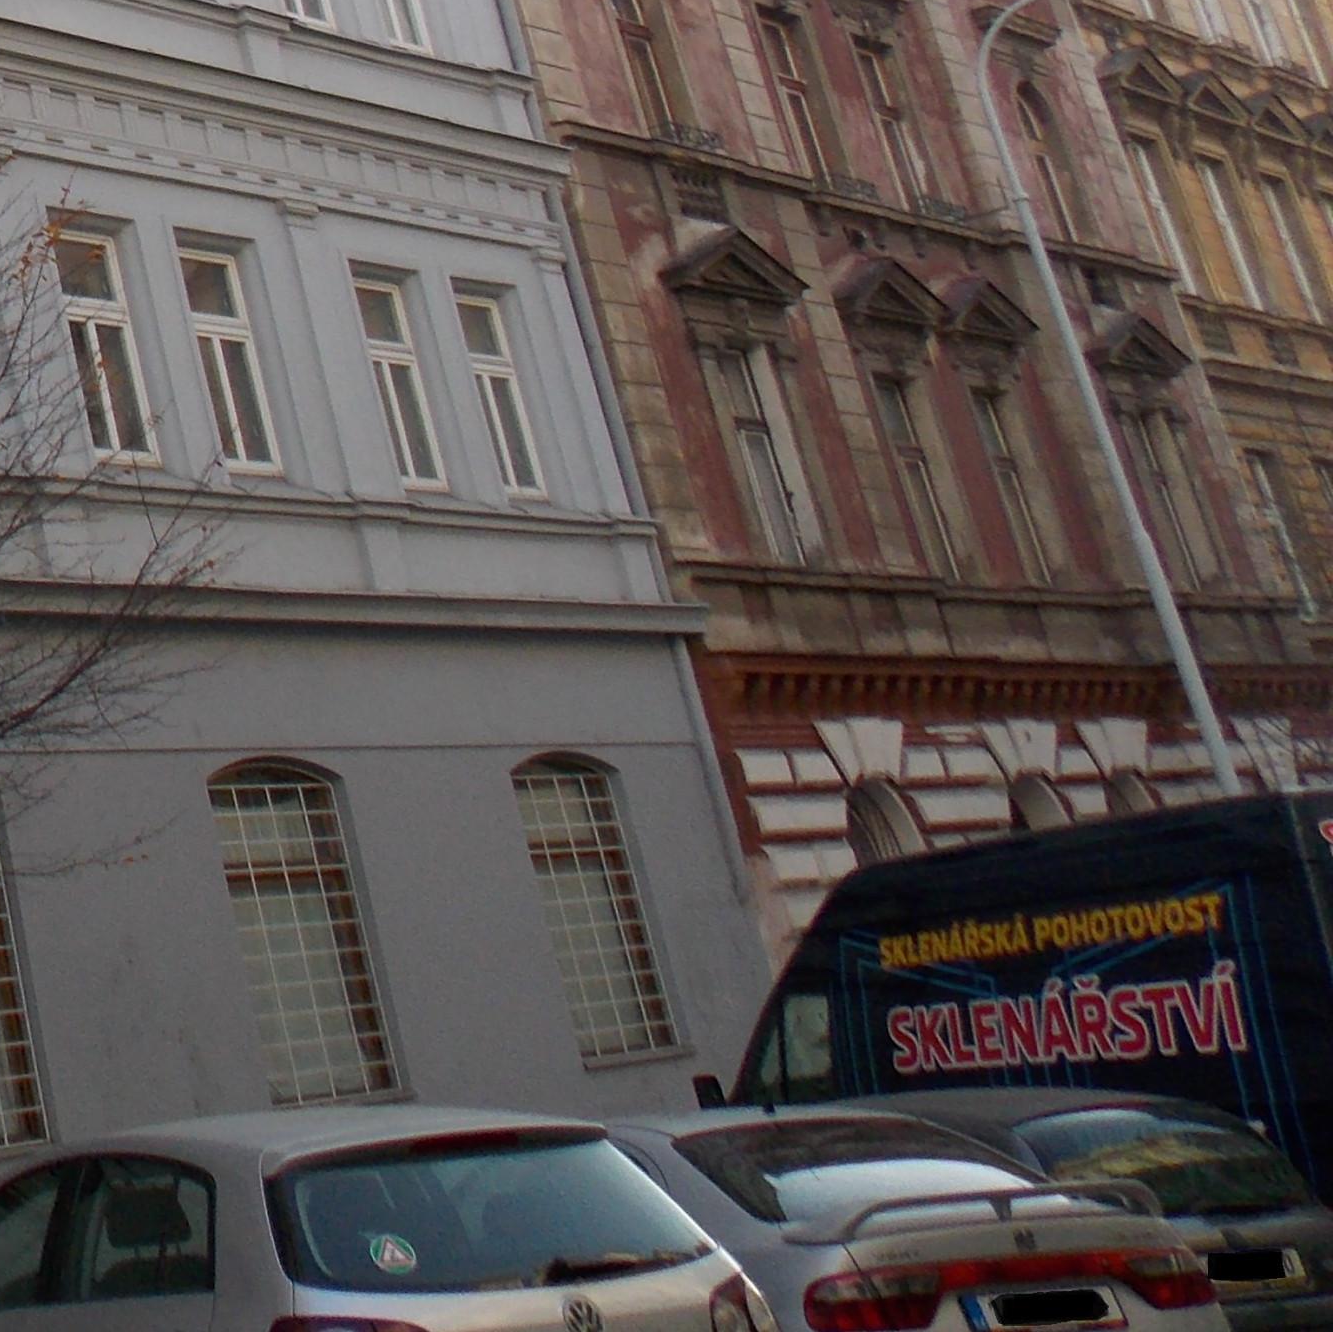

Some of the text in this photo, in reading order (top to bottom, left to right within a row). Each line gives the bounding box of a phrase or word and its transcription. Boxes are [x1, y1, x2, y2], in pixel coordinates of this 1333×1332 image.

[879, 894, 1223, 967] SKLENÁŘSKÁ POHOTOVOST
[888, 960, 1247, 1073] SKLENÁŘSTVÍ
